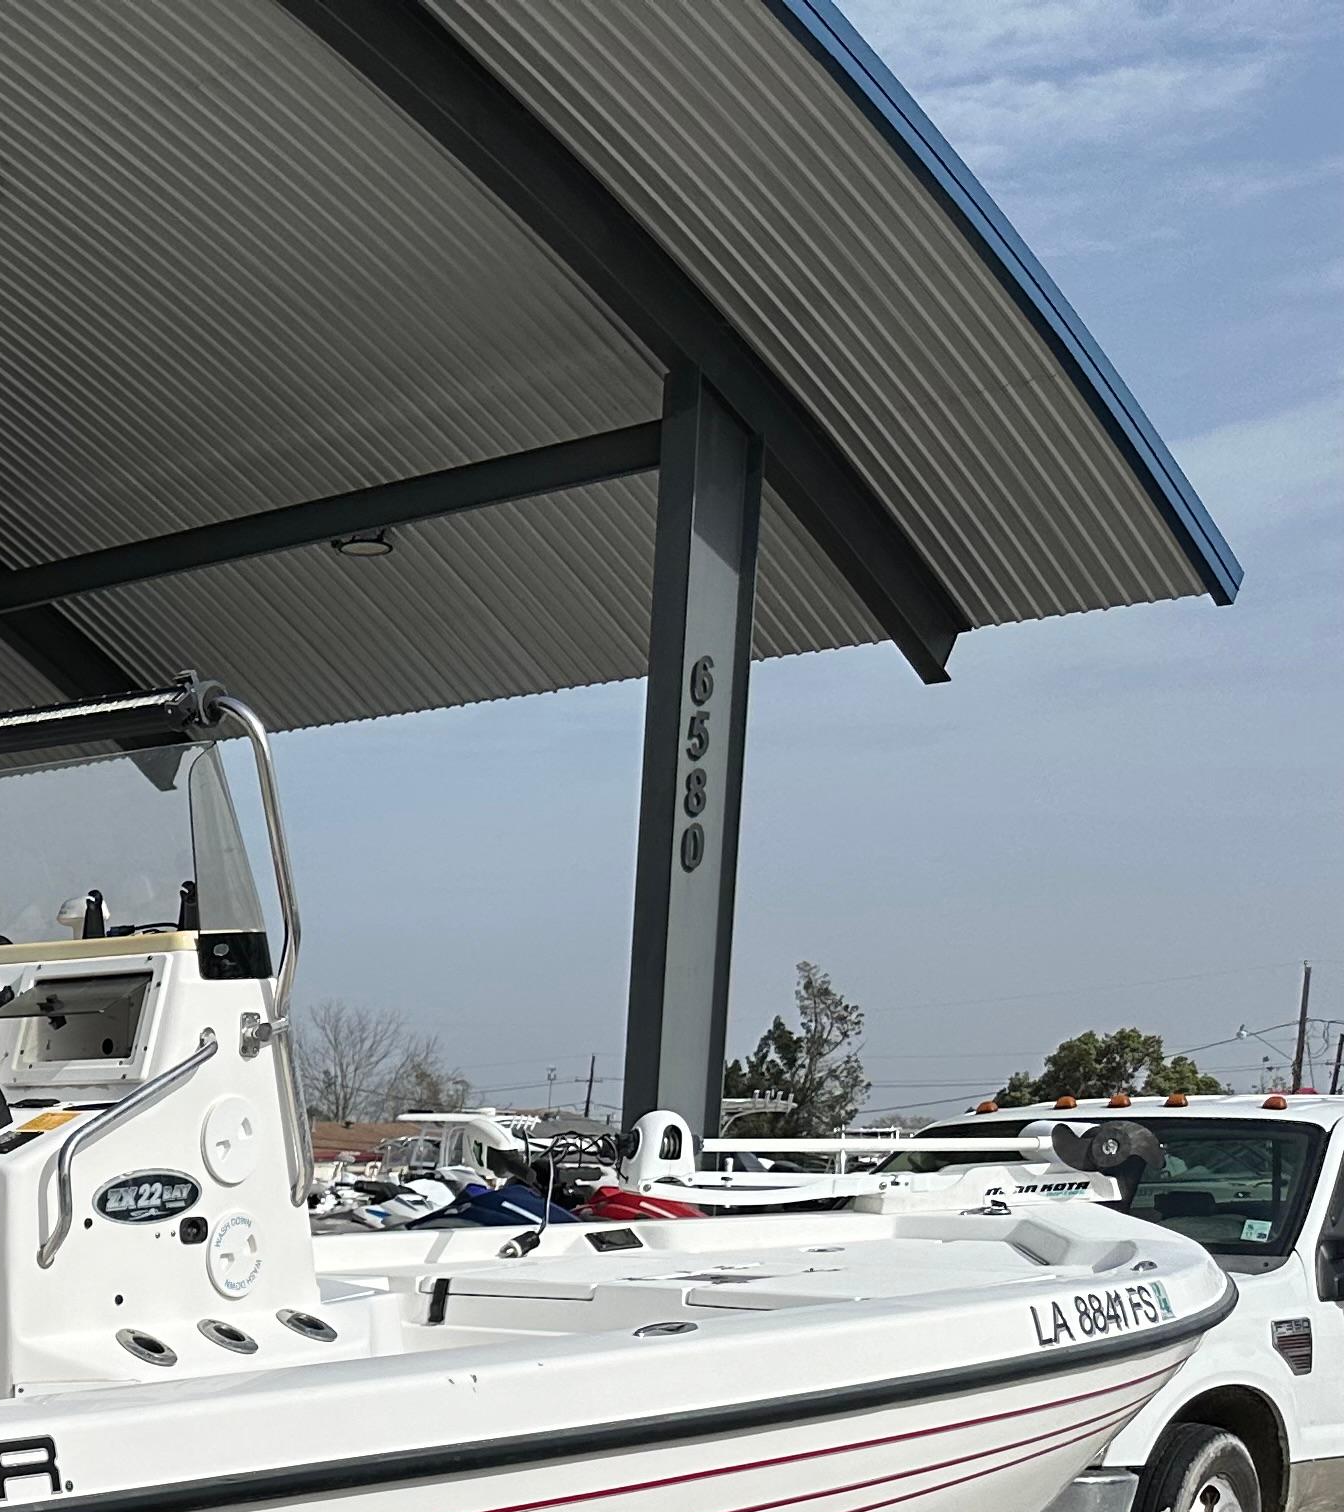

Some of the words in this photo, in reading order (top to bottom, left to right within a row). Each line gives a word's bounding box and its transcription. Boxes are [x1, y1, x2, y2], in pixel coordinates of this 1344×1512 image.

[680, 654, 715, 874] 6580
[1040, 1181, 1091, 1192] KOTA
[1030, 1301, 1076, 1346] LA
[1074, 1290, 1129, 1336] 8841
[1125, 1285, 1159, 1325] FS
